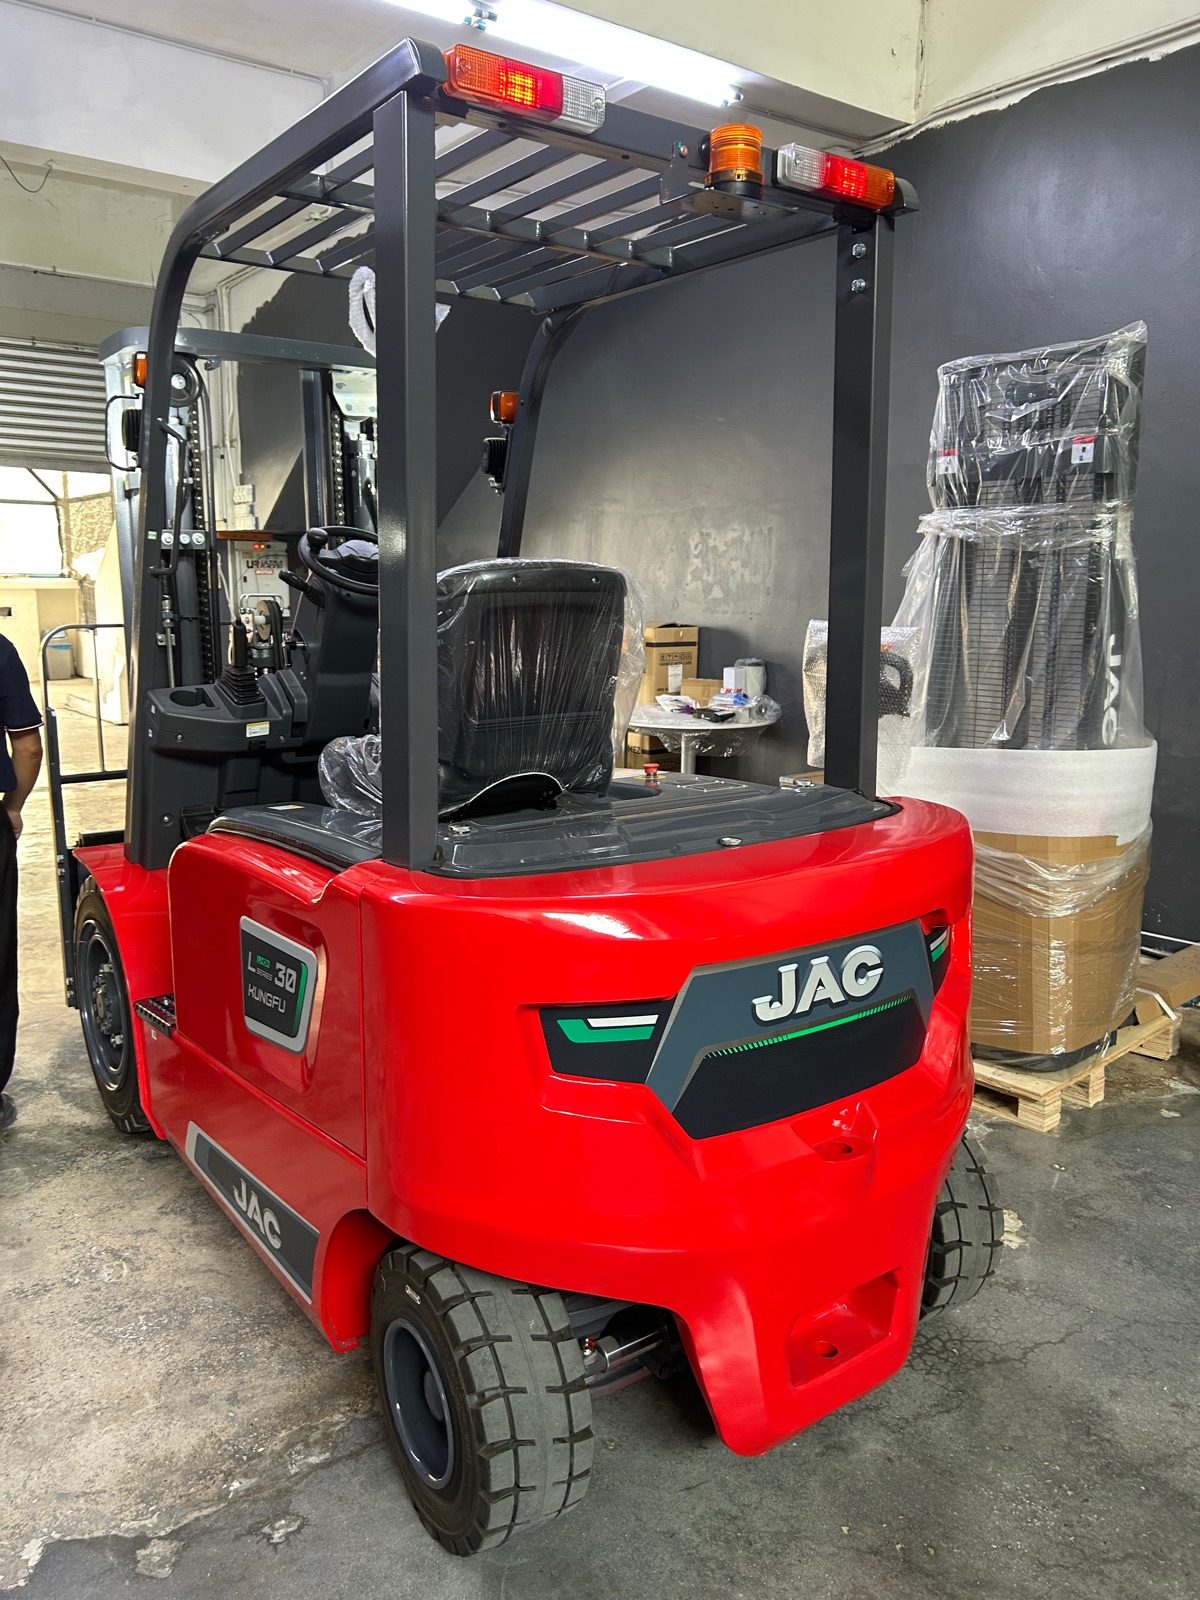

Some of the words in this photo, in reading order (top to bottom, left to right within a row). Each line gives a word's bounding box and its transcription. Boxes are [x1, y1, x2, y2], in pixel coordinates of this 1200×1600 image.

[1101, 633, 1122, 746] JAC
[247, 951, 256, 973] L
[256, 967, 272, 981] SERIES
[274, 962, 297, 994] 30
[248, 983, 286, 1013] KUNGFU
[751, 944, 884, 1025] JAC
[232, 1177, 282, 1250] JAC
